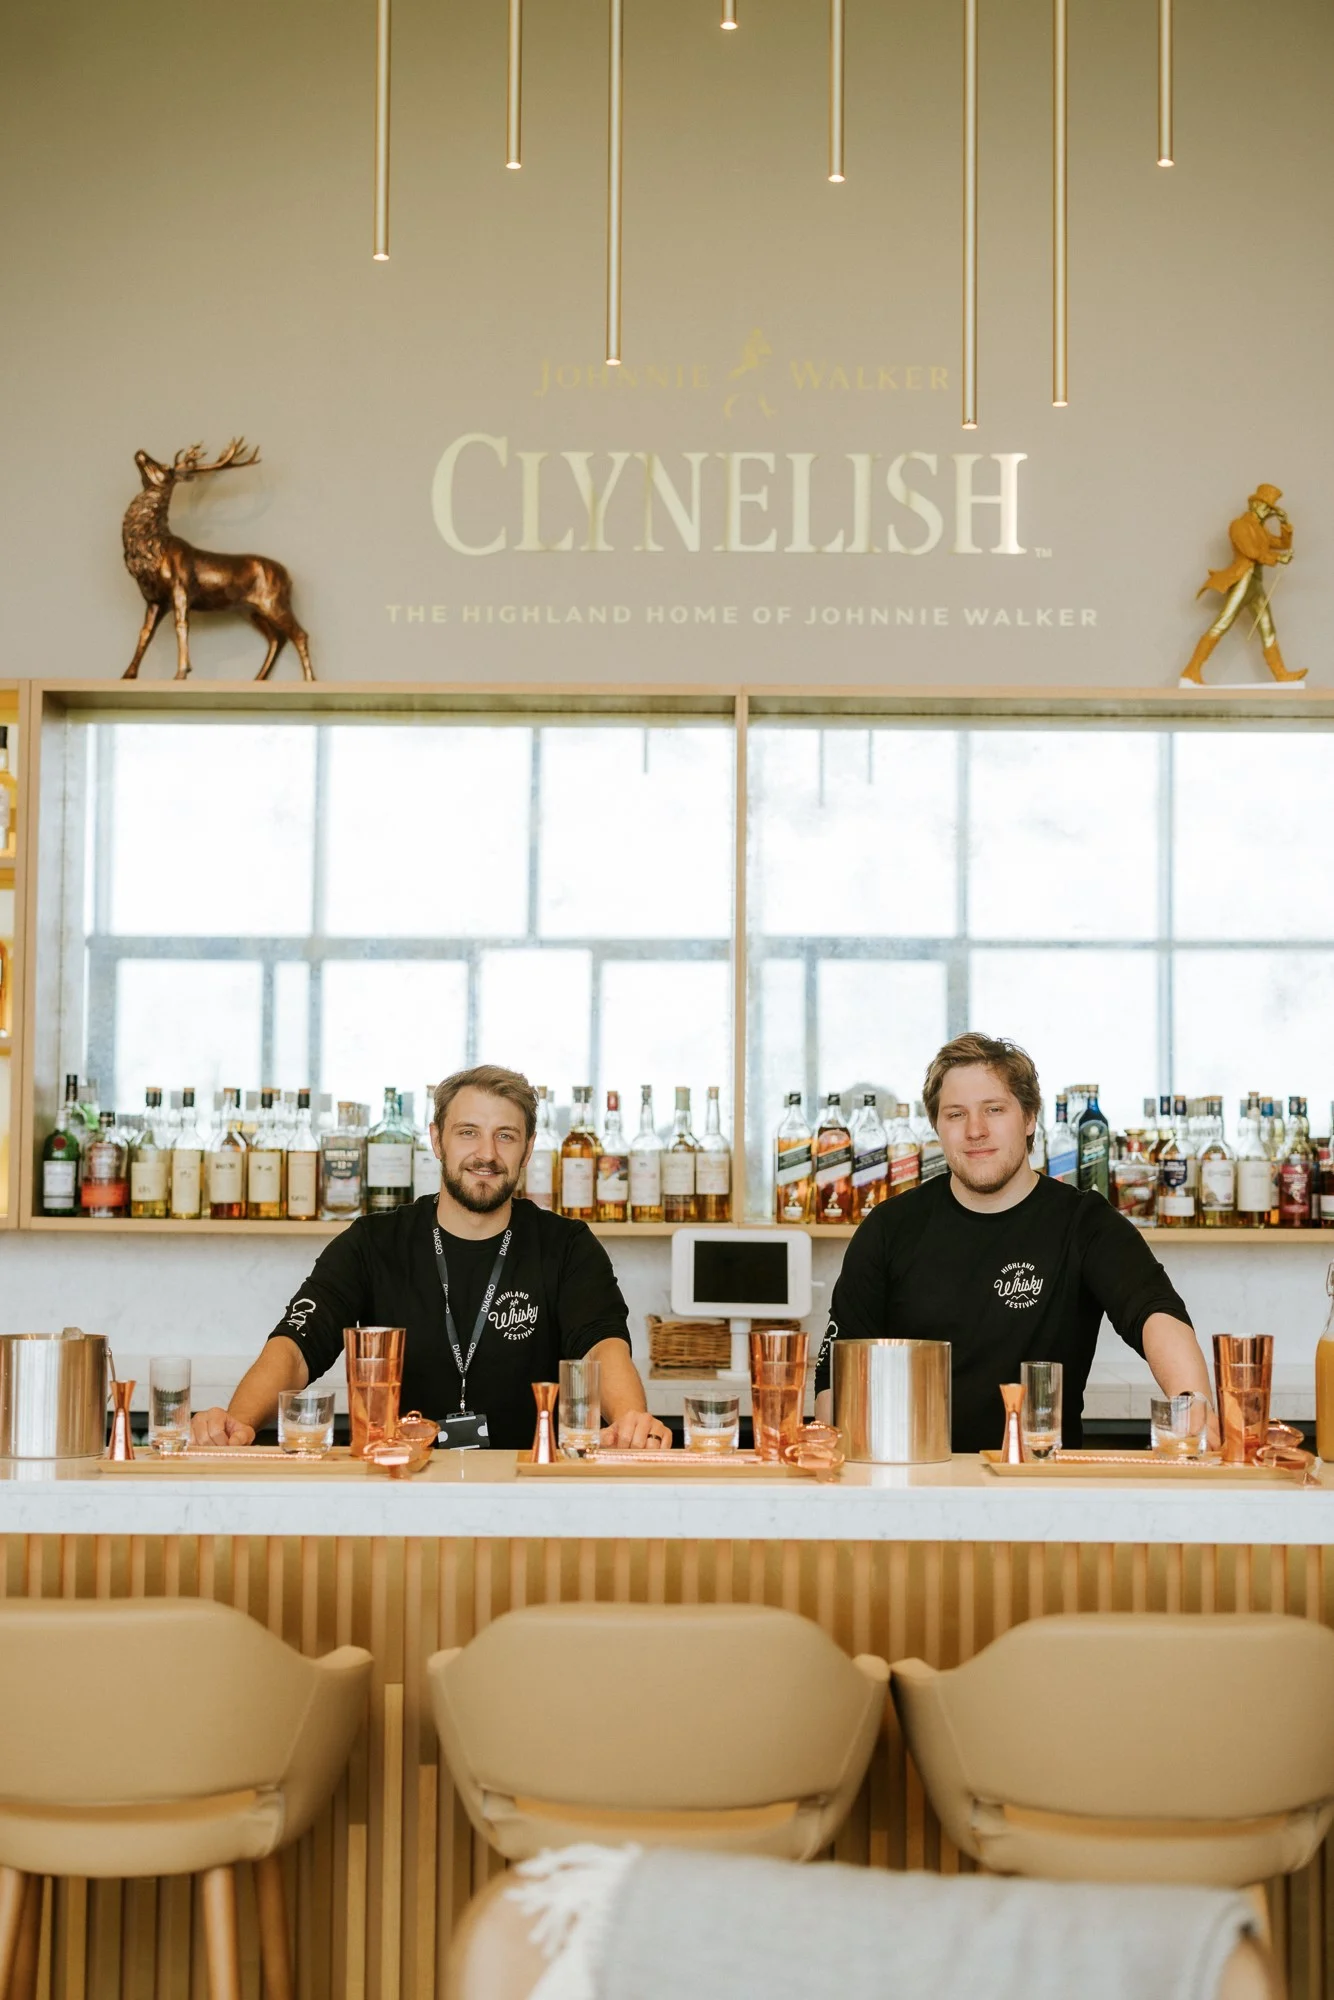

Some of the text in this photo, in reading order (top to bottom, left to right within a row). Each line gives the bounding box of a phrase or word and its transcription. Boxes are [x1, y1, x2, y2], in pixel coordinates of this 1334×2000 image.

[533, 359, 951, 397] JOHNNIE WALKER
[431, 432, 1029, 556] CLYNELISH
[386, 604, 1098, 627] THE HIGHLAND HOME OF JOHNNIE WALKER
[432, 1227, 443, 1255] DIAGEO
[499, 1229, 513, 1256] DIAGEO
[1000, 1262, 1035, 1275] HIGHLAND
[480, 1283, 496, 1313] DIAGEO
[993, 1274, 1044, 1297] Whisky
[495, 1291, 530, 1306] HIGHLAND
[1004, 1297, 1038, 1309] FESTIVAL
[488, 1303, 539, 1330] Whisky
[503, 1326, 536, 1341] FESTIVAL
